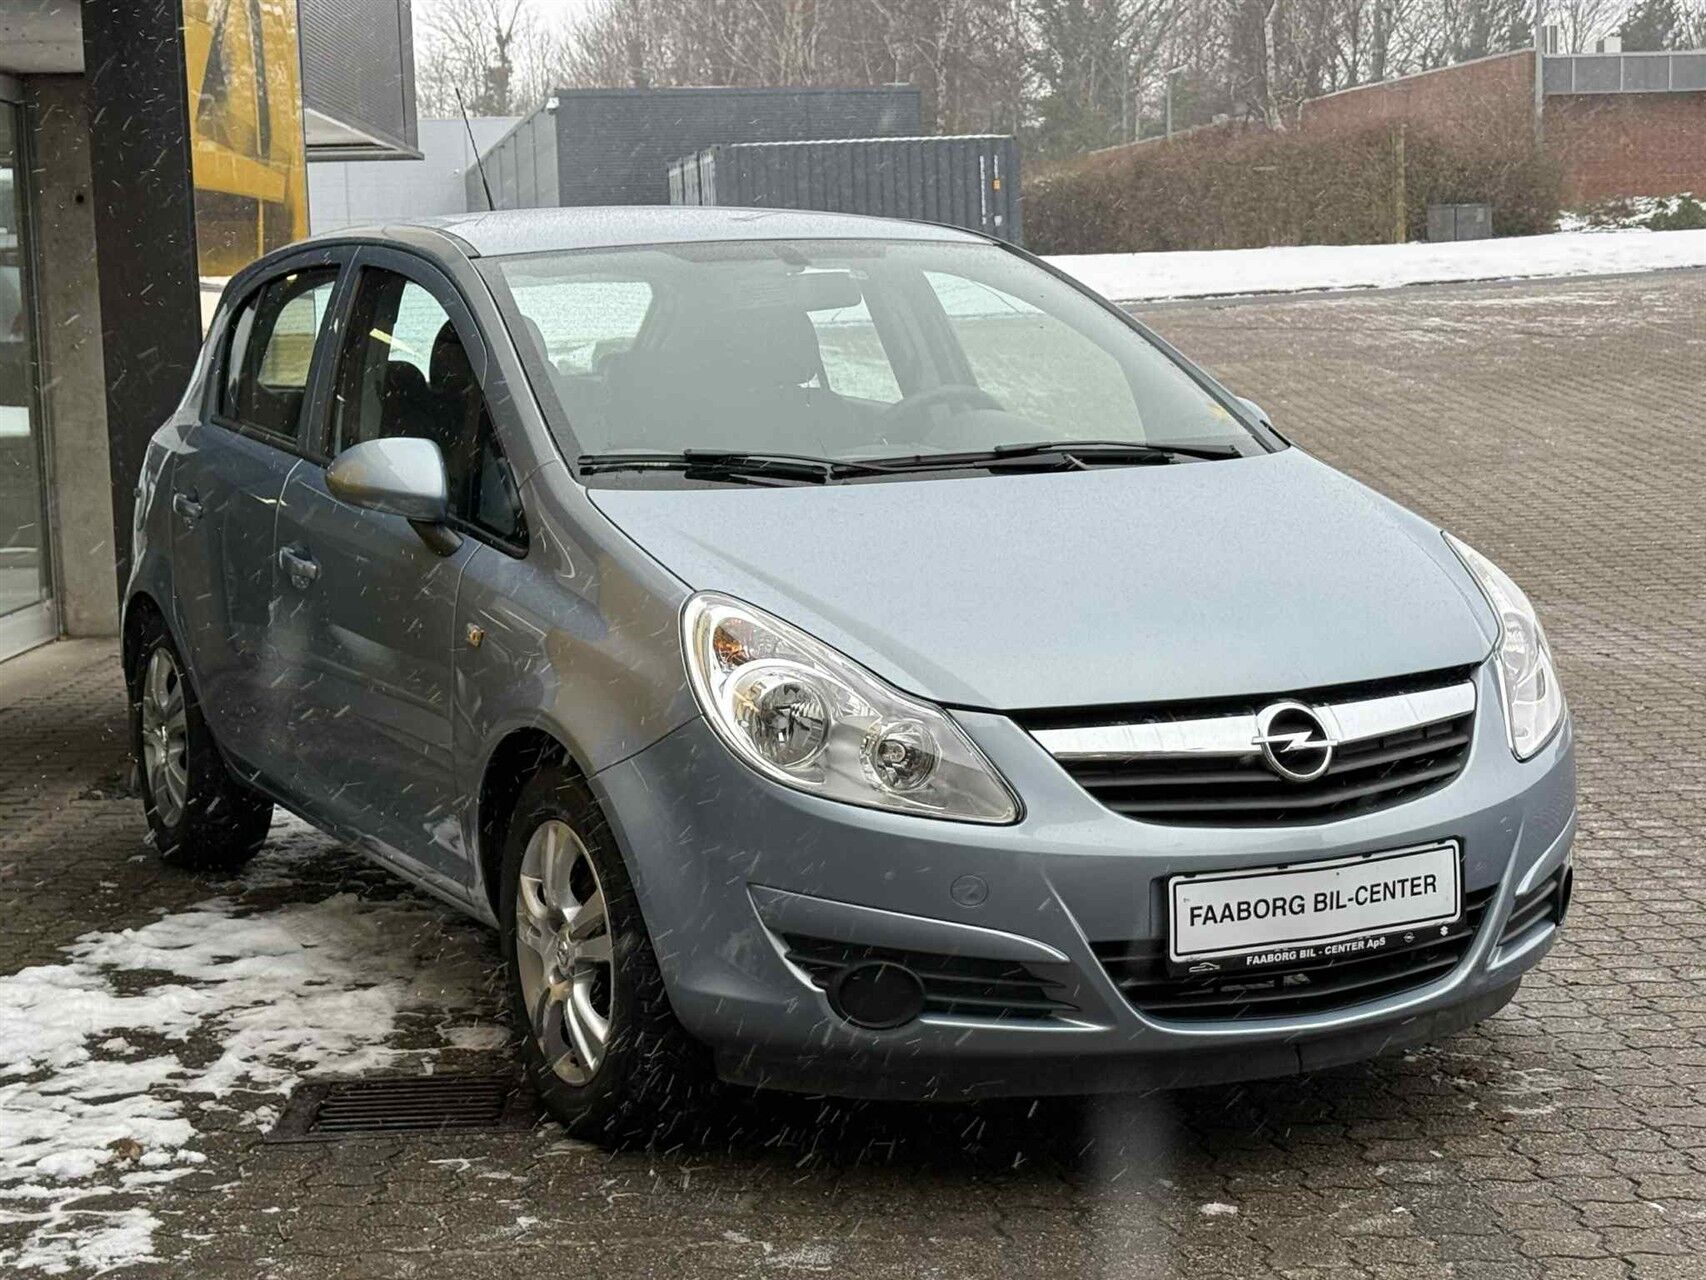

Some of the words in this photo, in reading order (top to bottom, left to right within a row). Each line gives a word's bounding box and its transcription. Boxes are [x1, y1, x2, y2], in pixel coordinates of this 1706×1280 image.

[1189, 895, 1305, 926] FAABORG
[1313, 874, 1437, 913] BIL-CENTER
[1246, 951, 1297, 966] FAABORG
[1299, 949, 1316, 959] BIL
[1325, 941, 1365, 955] CENTER
[1366, 938, 1386, 950] ApS
